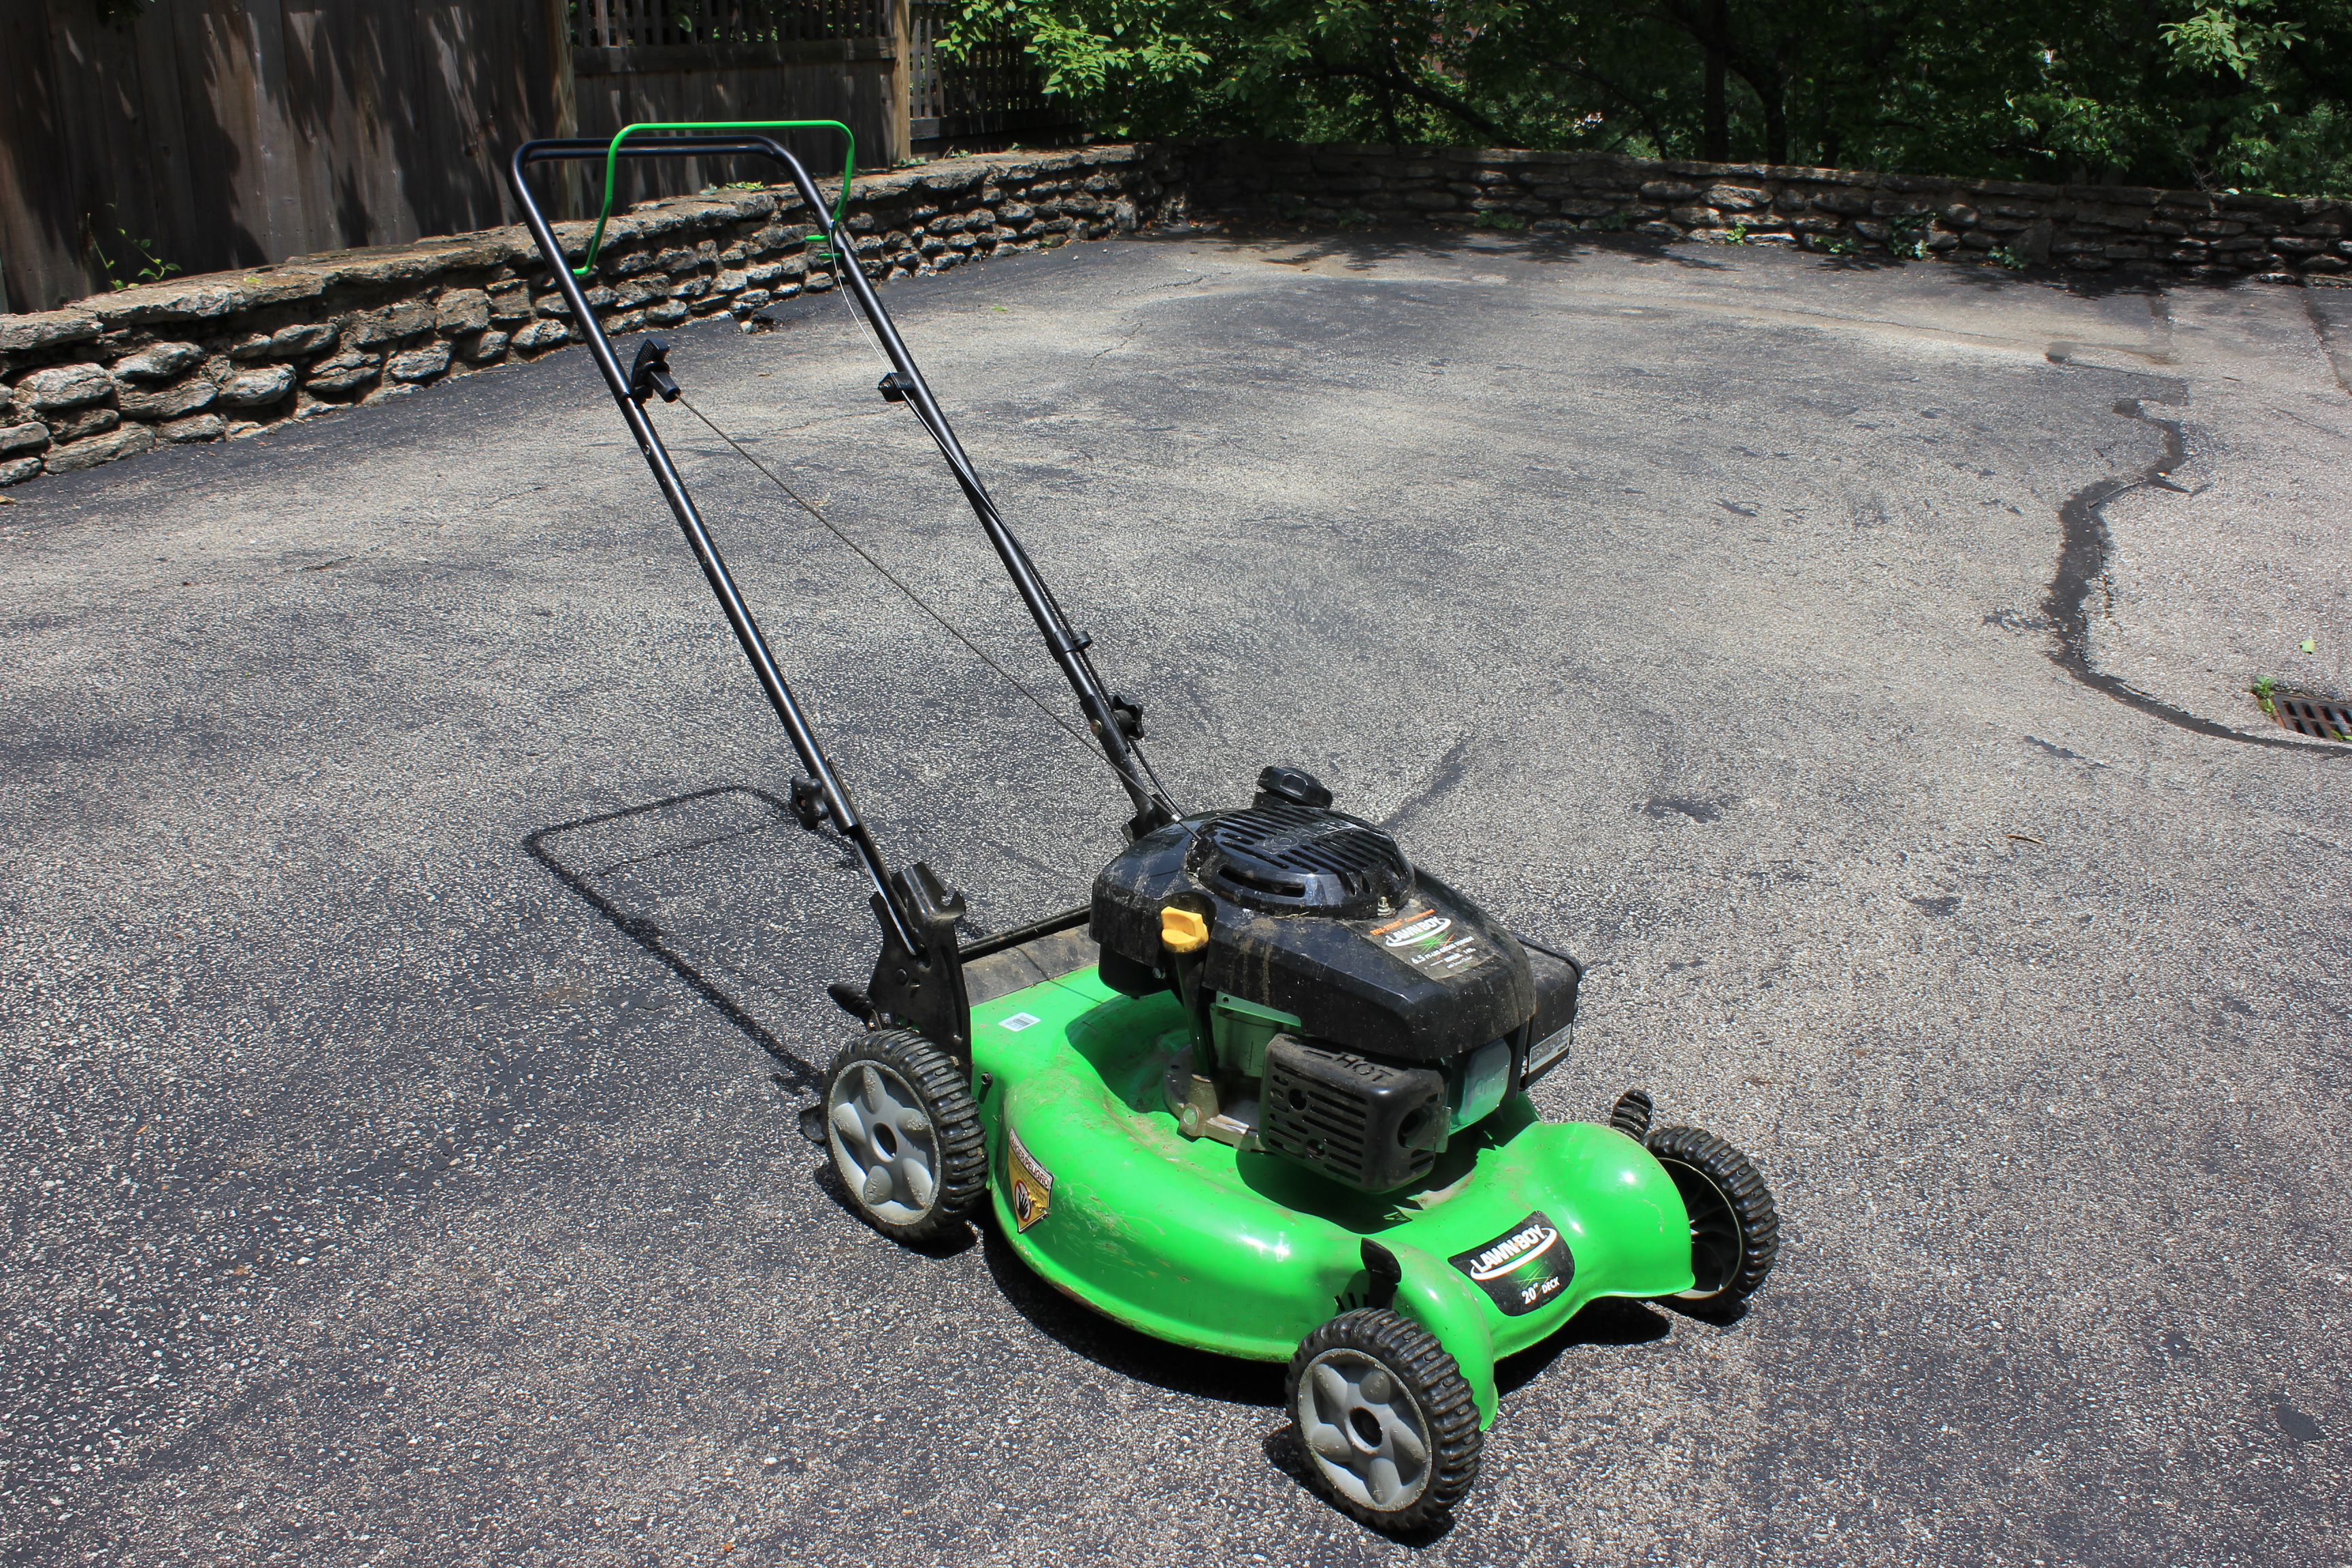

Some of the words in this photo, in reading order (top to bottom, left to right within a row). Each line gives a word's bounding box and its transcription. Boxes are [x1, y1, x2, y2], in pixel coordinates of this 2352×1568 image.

[1411, 954, 1426, 964] 6.5
[1439, 943, 1456, 953] GROSS
[1454, 936, 1475, 947] TORQUE
[1335, 1054, 1394, 1082] HOT
[1541, 1276, 1561, 1294] DECK
